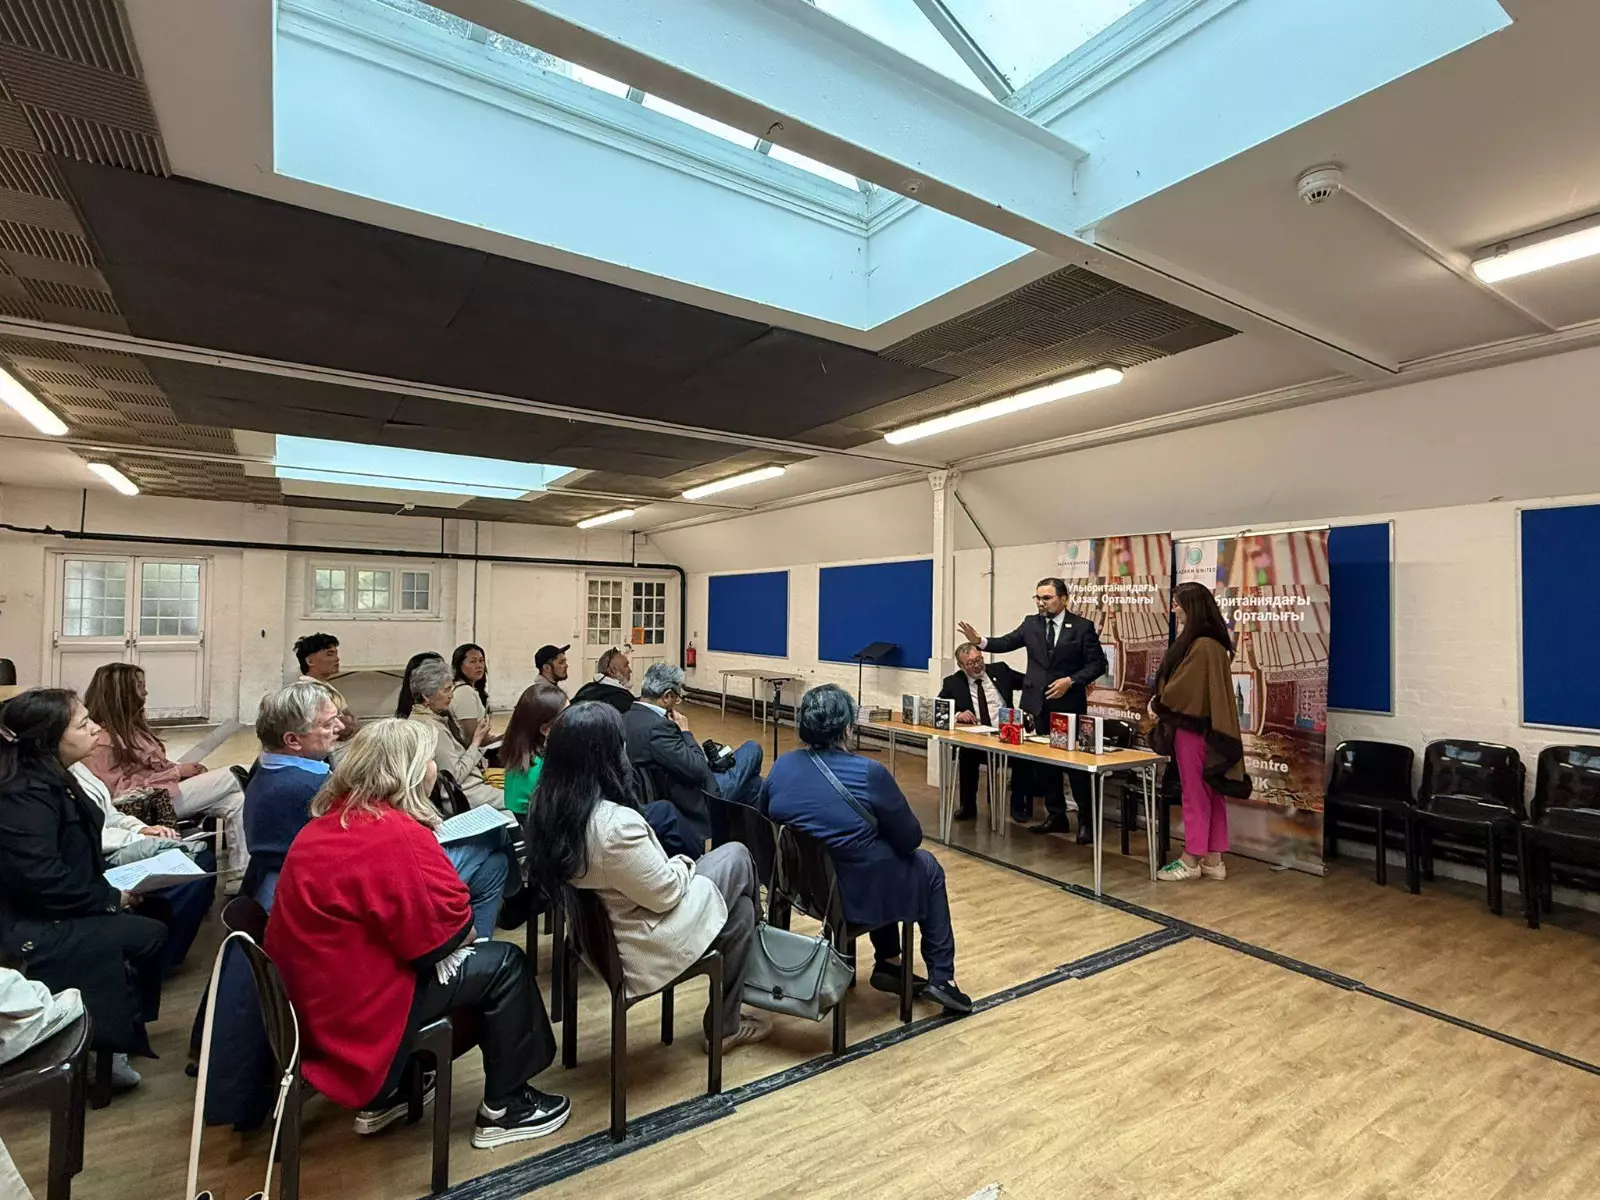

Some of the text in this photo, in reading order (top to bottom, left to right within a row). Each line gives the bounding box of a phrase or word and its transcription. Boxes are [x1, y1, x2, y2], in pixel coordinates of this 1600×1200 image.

[1101, 594, 1154, 606] Орталығы
[1214, 595, 1311, 609] британиядағы
[1233, 609, 1305, 624] Орталығы
[1108, 707, 1141, 720] Centre
